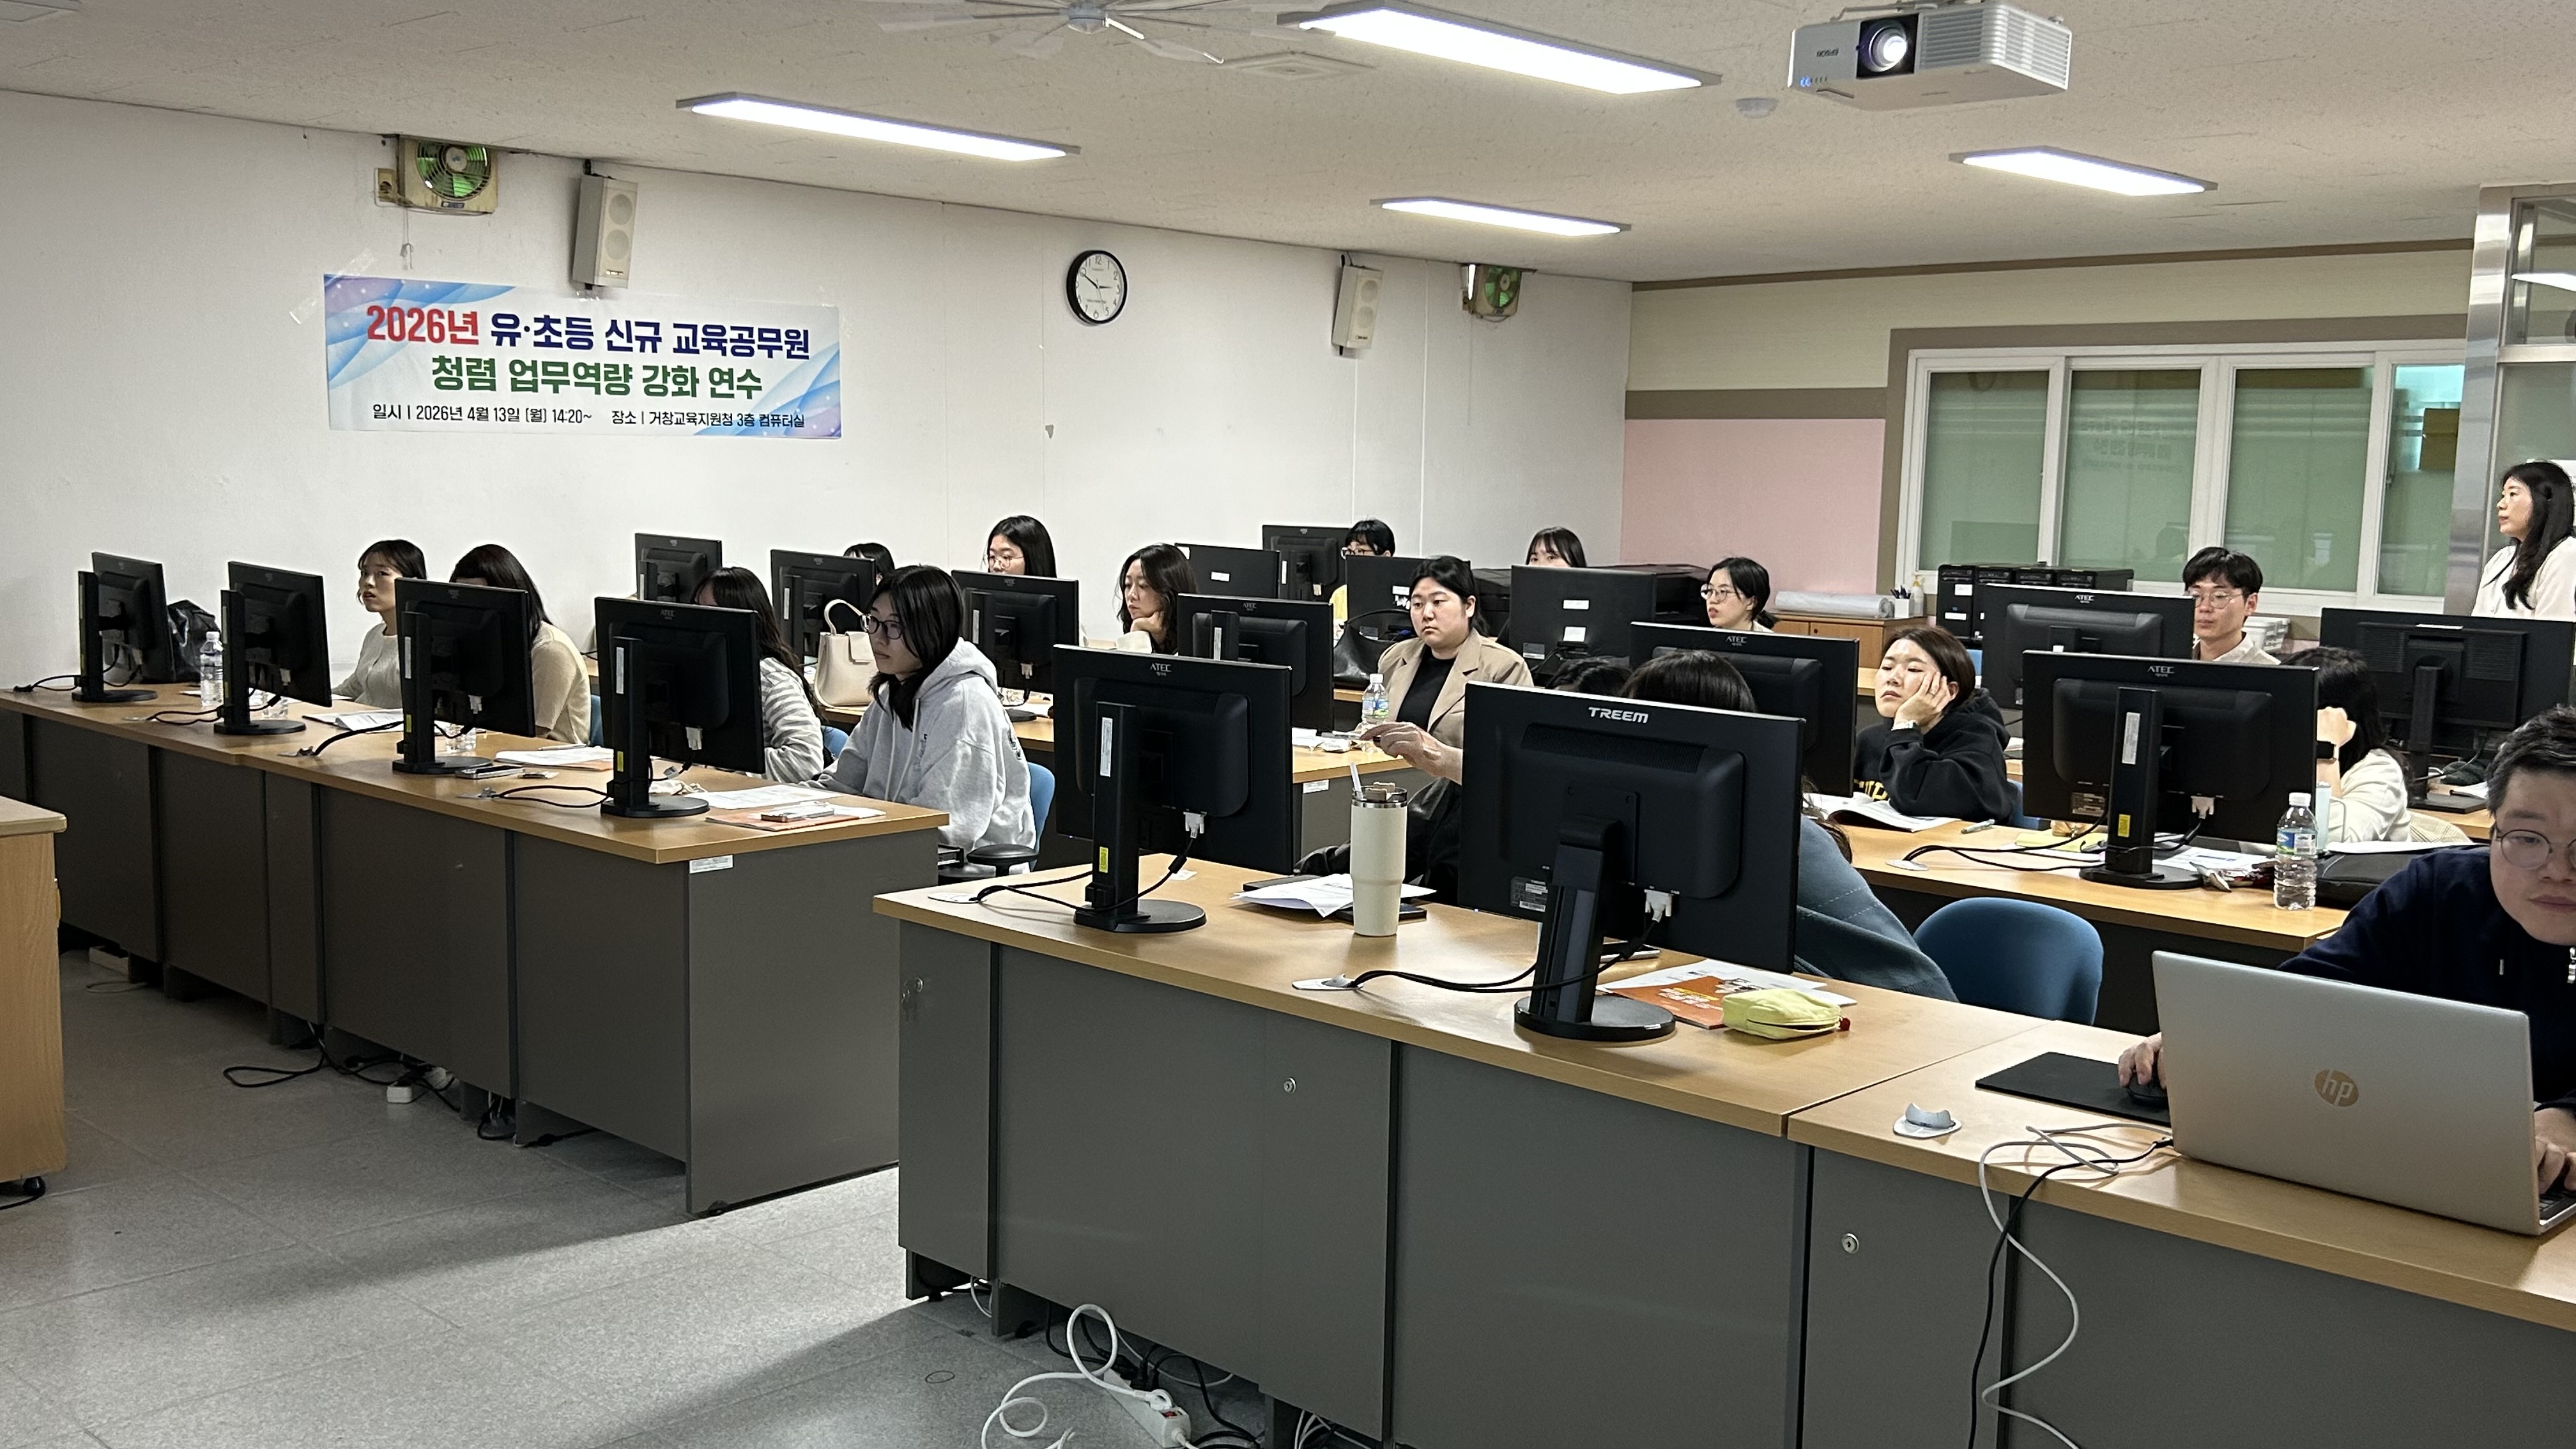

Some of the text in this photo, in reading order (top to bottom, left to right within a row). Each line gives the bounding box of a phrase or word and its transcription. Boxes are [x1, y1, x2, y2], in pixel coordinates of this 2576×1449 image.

[1085, 258, 1091, 268] 11
[1095, 255, 1101, 265] 12
[1093, 310, 1099, 319] 6
[367, 305, 809, 360] 2026년 유·초등 신규 교육공무원
[432, 355, 762, 399] 청렴 업무역량 강화 연수
[372, 404, 402, 420] 일시
[416, 405, 463, 421] 2026년
[467, 407, 489, 422] 4월
[493, 408, 520, 422] 13일
[552, 409, 592, 424] 14:20~
[611, 410, 637, 425] 장소
[649, 411, 733, 427] 거창교육지원청
[737, 413, 755, 427] 3층
[758, 413, 805, 428] 컴퓨터실
[1725, 636, 1747, 644] ATEC
[1149, 663, 1172, 673] ATEC
[2147, 666, 2175, 674] ATEC
[1588, 707, 1649, 723] TREEM
[2320, 1070, 2354, 1105] hp
